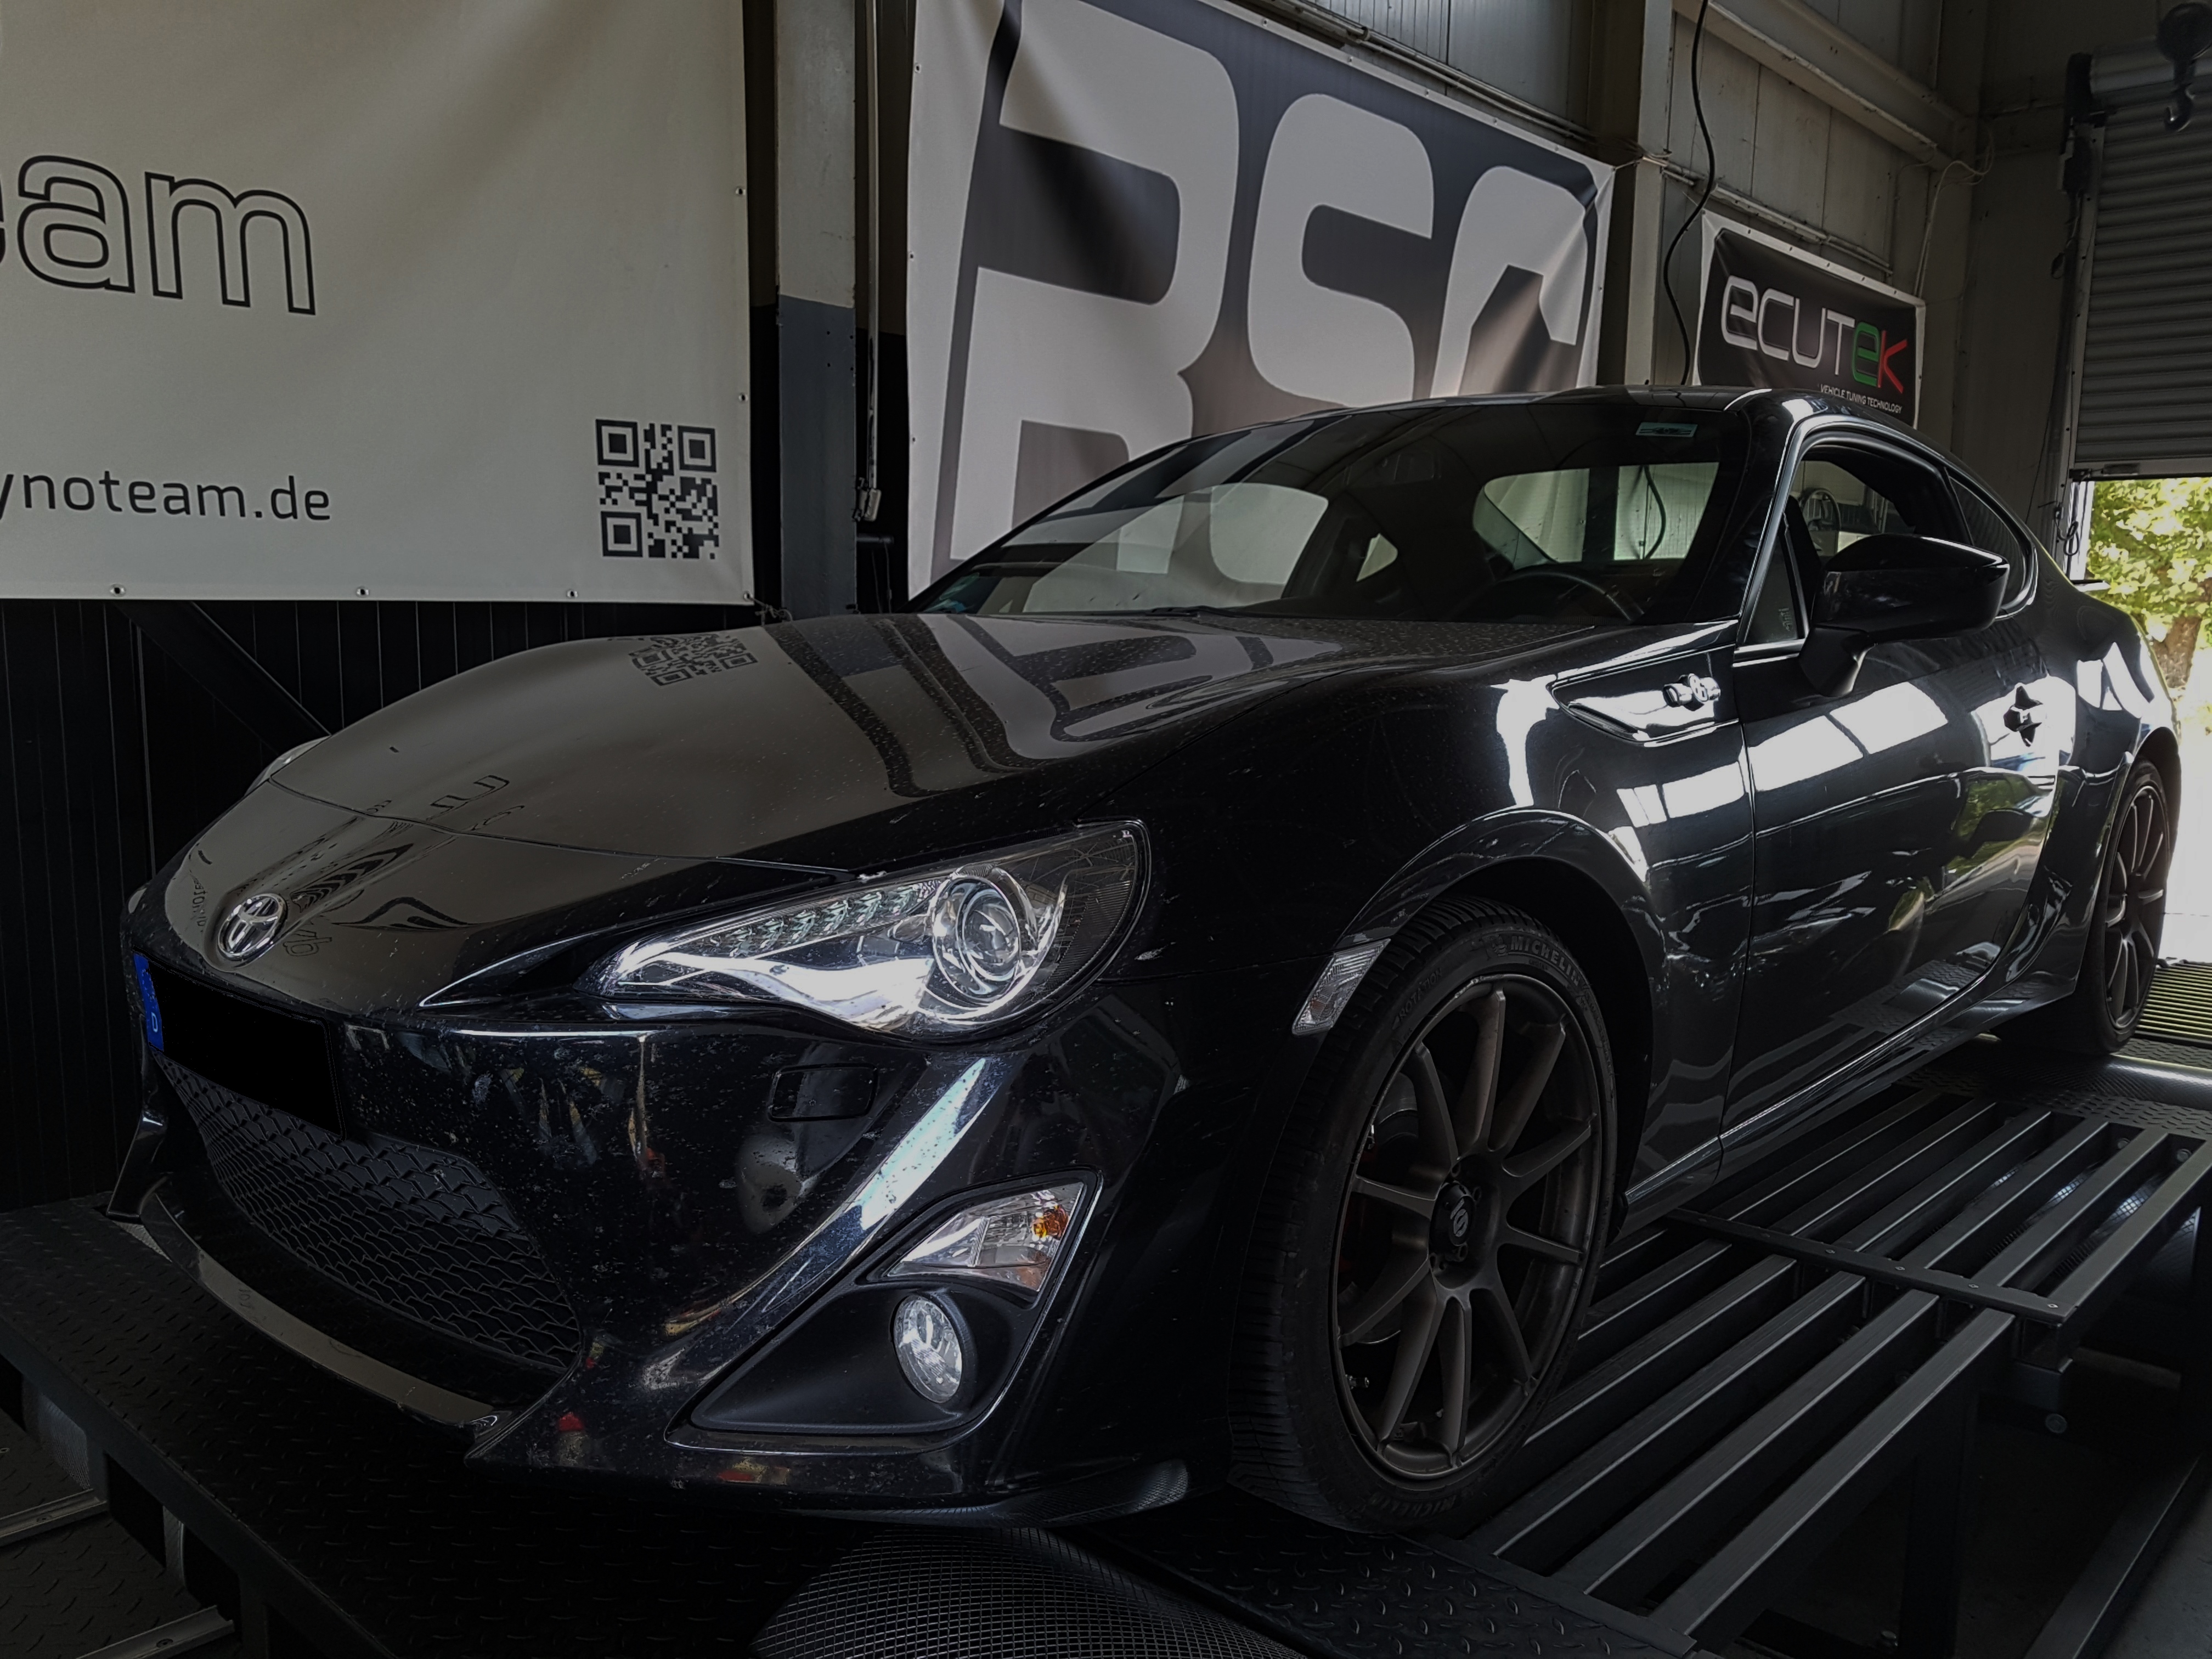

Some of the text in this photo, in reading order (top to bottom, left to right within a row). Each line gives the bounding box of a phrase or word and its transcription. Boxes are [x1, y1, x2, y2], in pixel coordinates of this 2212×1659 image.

[0, 155, 316, 315] am
[1820, 383, 1903, 414] VEHICLE TUNING TECHNOLOGY
[1510, 935, 1581, 986] MICHELIN
[1400, 968, 1443, 1021] ROTATION
